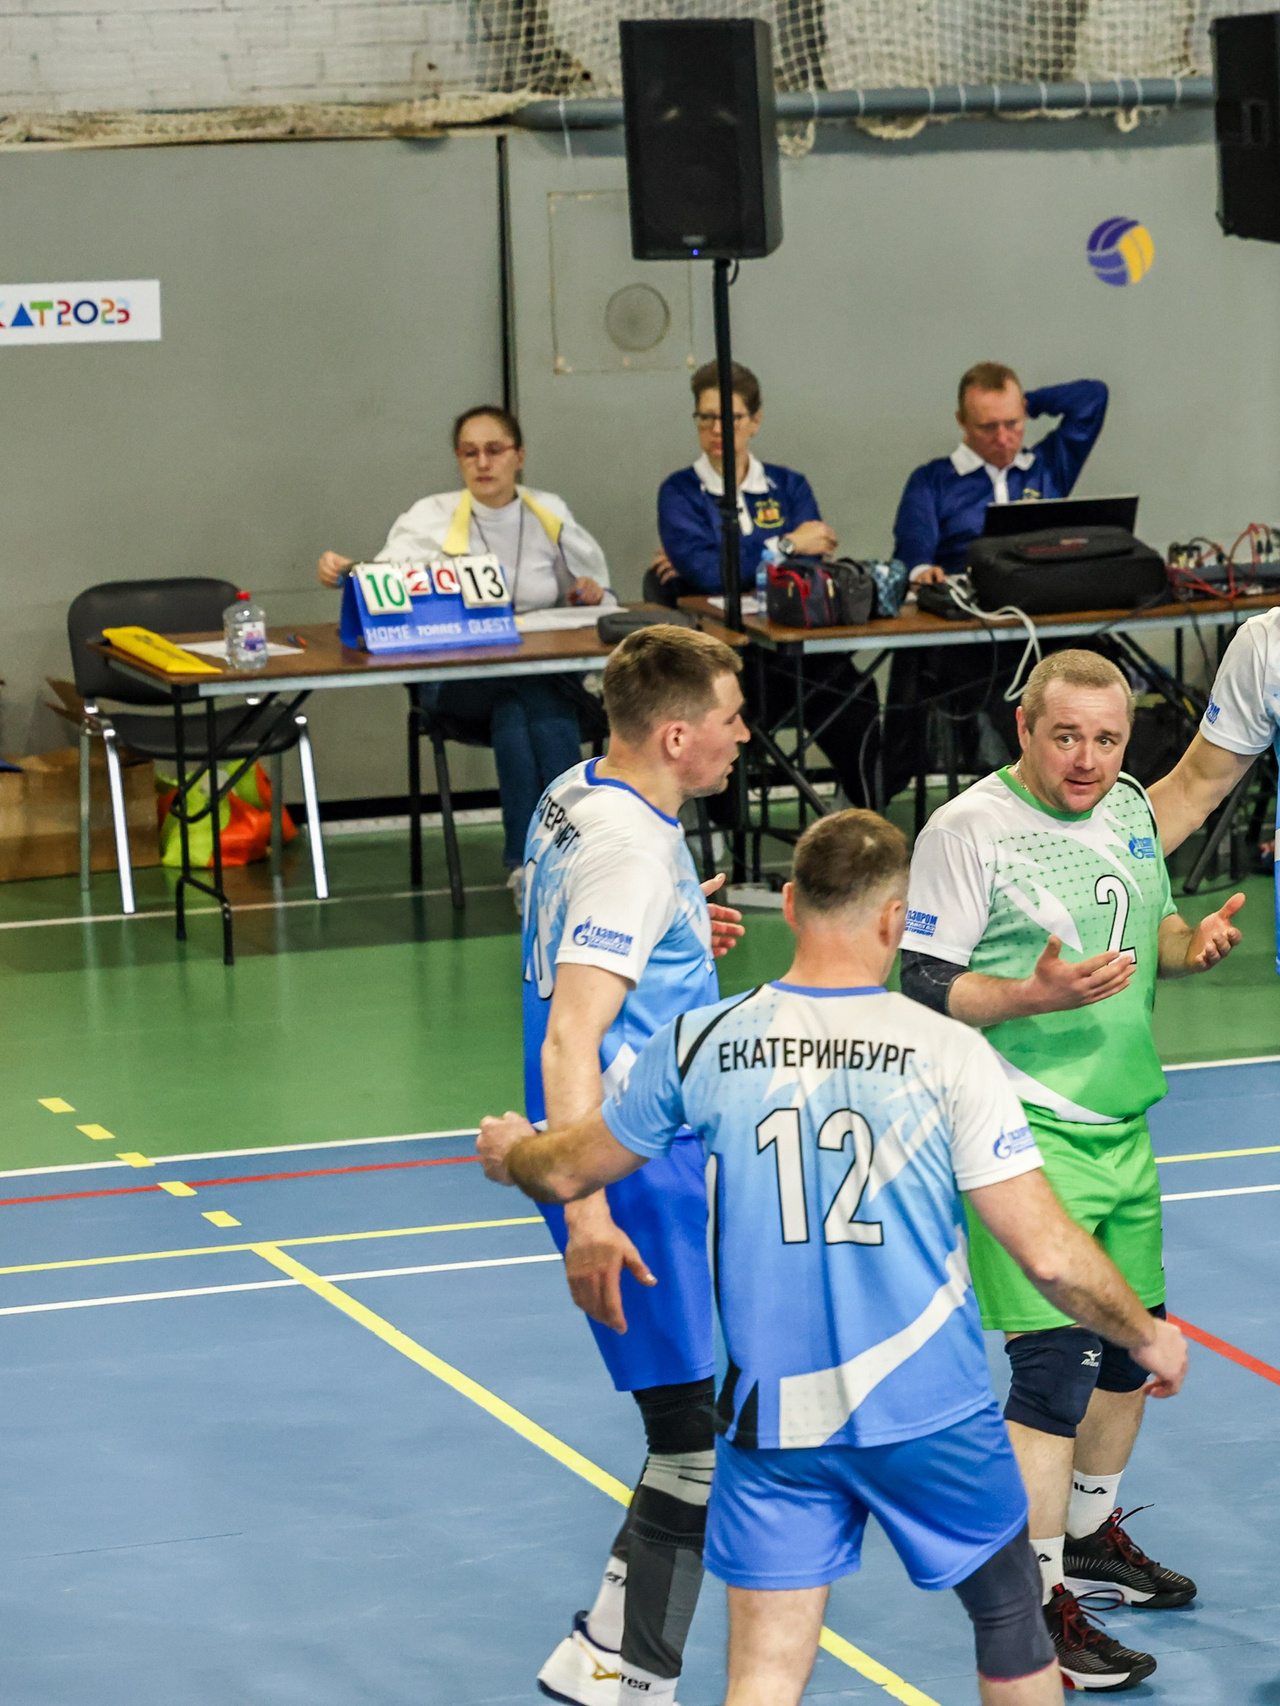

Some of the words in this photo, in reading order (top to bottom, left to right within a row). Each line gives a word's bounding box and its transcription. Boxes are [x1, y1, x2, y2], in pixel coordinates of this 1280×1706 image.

[0, 298, 131, 329] AT2023
[365, 573, 406, 608] 10
[464, 565, 504, 600] 13
[365, 624, 412, 642] HOME
[467, 617, 512, 635] GUEST
[1094, 874, 1138, 965] 2
[718, 1037, 916, 1076] ЕКАТЕРИНБУРГ
[755, 1107, 885, 1246] 12
